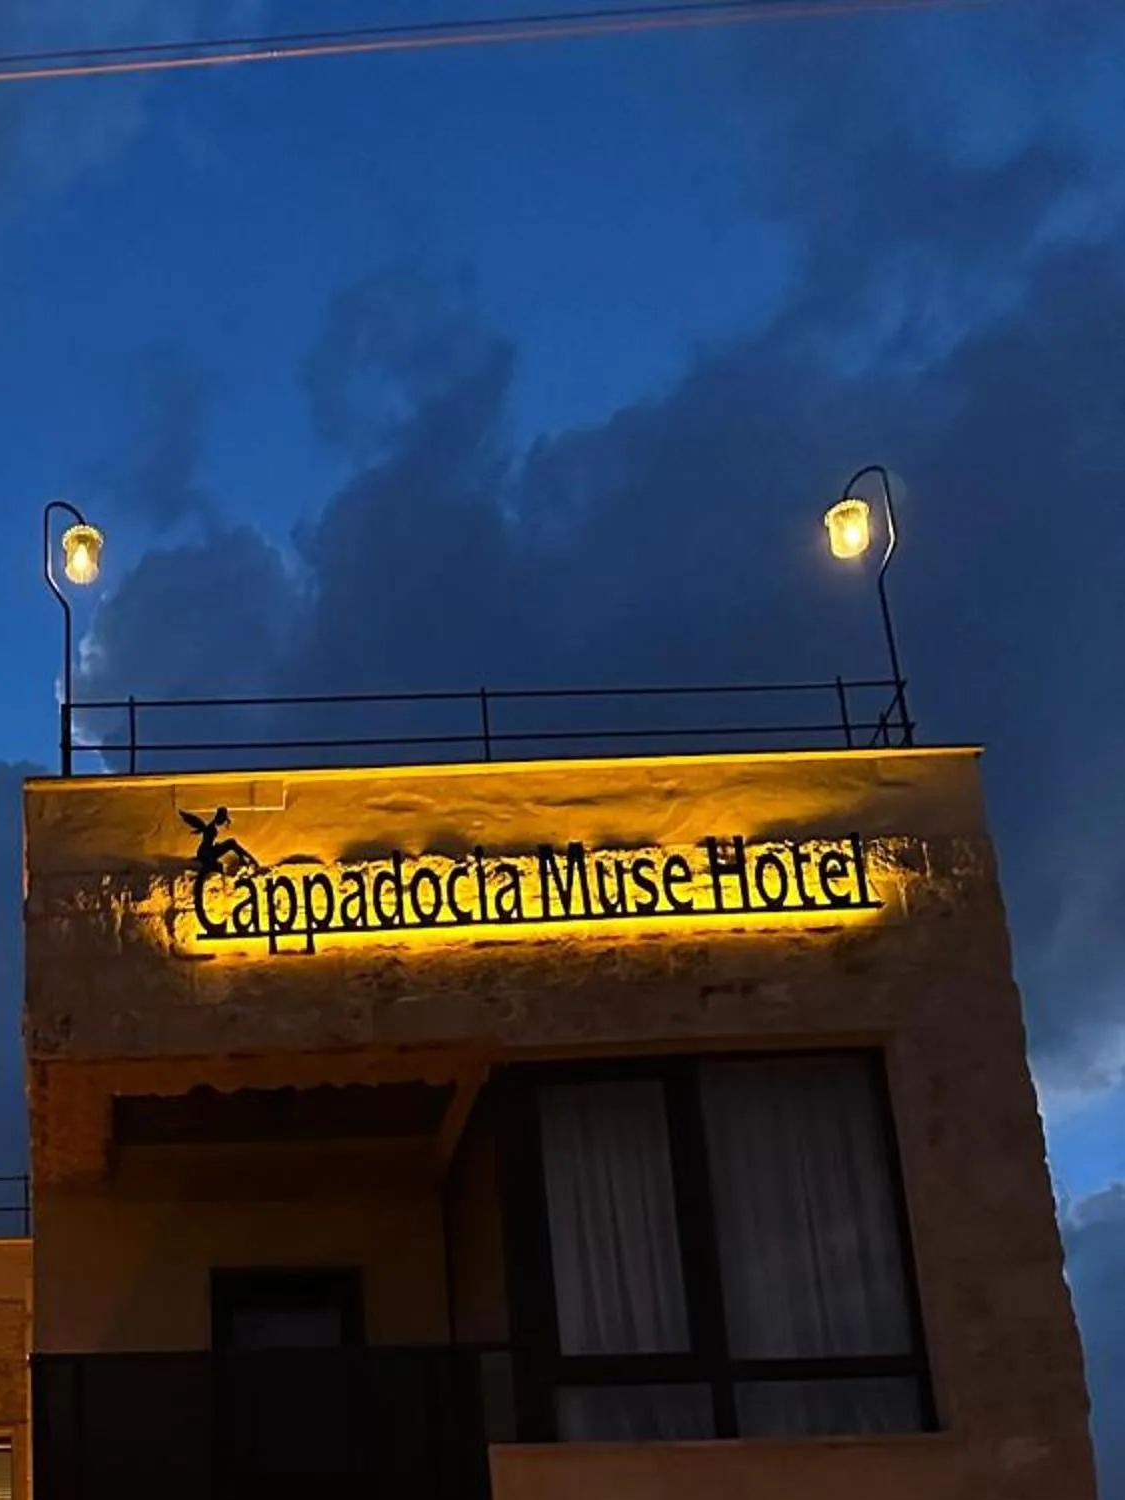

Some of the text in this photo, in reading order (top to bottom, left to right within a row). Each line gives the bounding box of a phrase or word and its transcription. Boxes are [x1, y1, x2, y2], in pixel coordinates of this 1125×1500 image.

[194, 832, 869, 954] Cappadocia Muse Hotel
